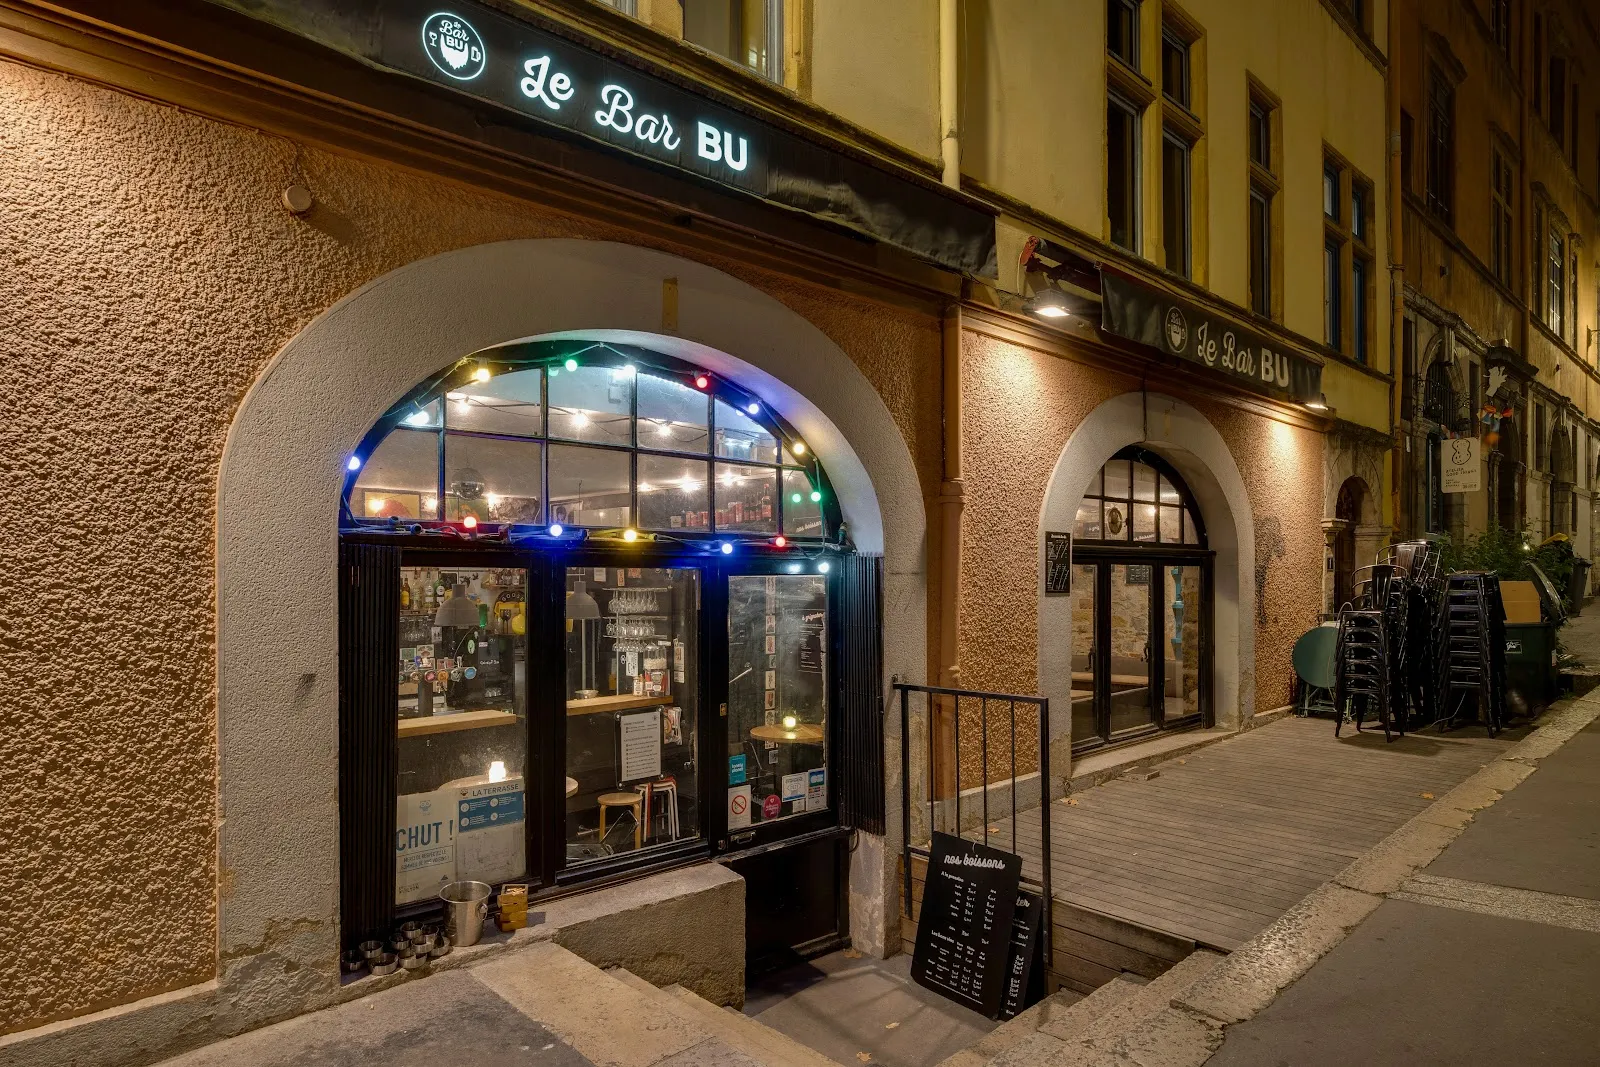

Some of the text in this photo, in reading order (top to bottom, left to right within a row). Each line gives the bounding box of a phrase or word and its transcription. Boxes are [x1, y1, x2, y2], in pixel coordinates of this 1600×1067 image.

[439, 20, 470, 42] Bar
[446, 35, 464, 50] BU
[520, 55, 748, 172] Le Bar BU
[1197, 321, 1289, 388] Le Bar BU
[472, 784, 519, 797] LA TERRASSE
[396, 819, 454, 851] CHUT !
[943, 853, 1006, 870] nos boissons
